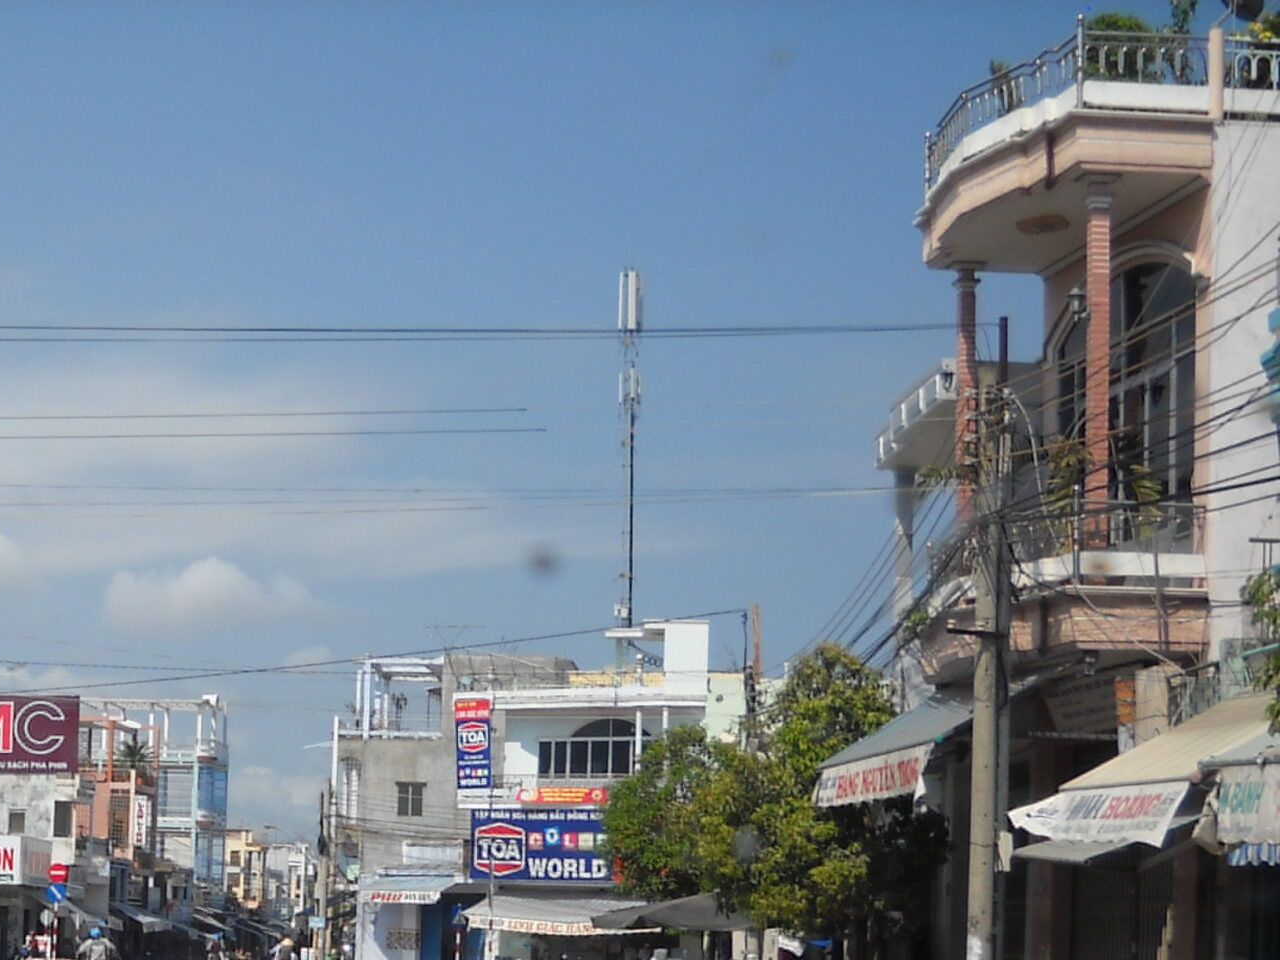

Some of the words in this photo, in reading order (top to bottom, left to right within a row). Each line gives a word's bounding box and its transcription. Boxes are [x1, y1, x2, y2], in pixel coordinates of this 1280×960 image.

[462, 730, 485, 744] TOA
[478, 839, 521, 860] TOA
[528, 857, 609, 879] WORLD
